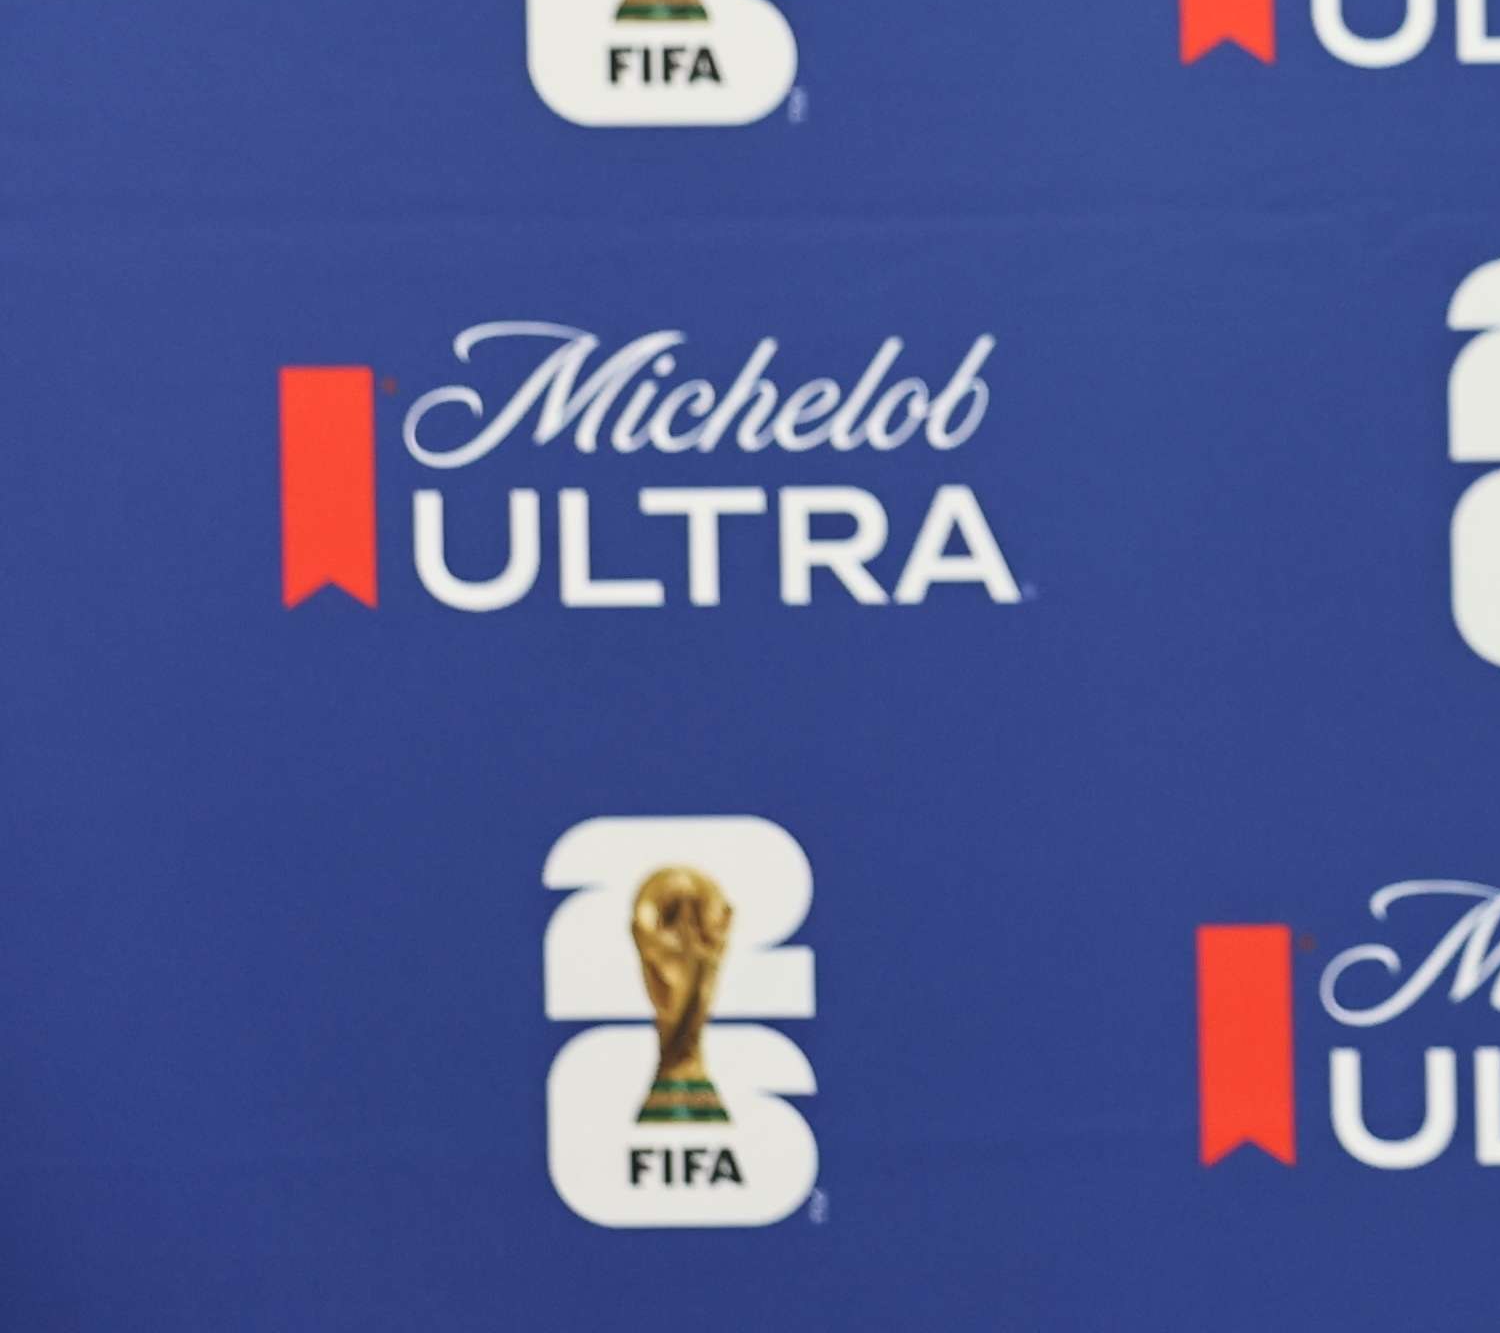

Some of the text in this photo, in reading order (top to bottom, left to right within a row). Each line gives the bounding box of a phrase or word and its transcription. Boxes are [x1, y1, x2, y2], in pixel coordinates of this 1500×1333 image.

[607, 44, 724, 87] FIFA
[402, 320, 996, 470] Michelob
[412, 483, 1022, 613] ULTRA
[627, 1146, 745, 1188] FIFA
